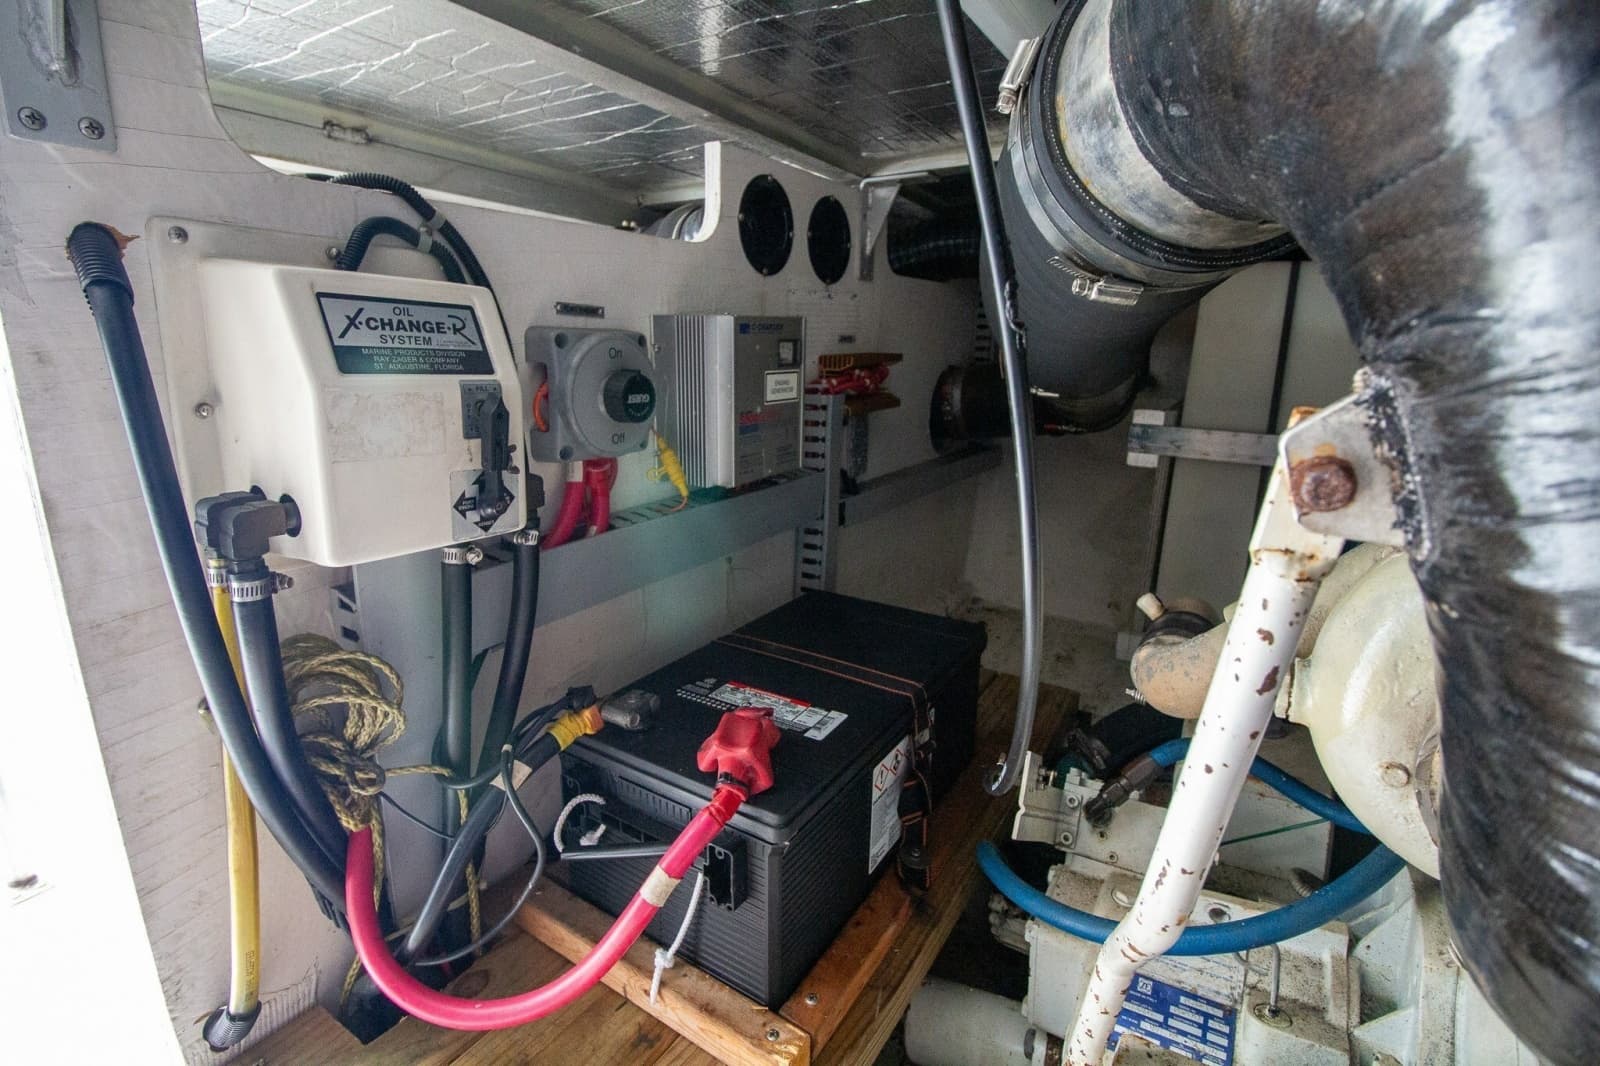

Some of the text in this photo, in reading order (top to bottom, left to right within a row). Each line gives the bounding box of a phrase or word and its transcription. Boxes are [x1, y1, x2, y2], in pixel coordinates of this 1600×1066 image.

[392, 306, 414, 317] OIL
[380, 334, 432, 345] SYSTEM
[361, 348, 466, 358] MARINE PRODUCTS DIVISION
[608, 347, 623, 359] On
[611, 433, 625, 444] Off
